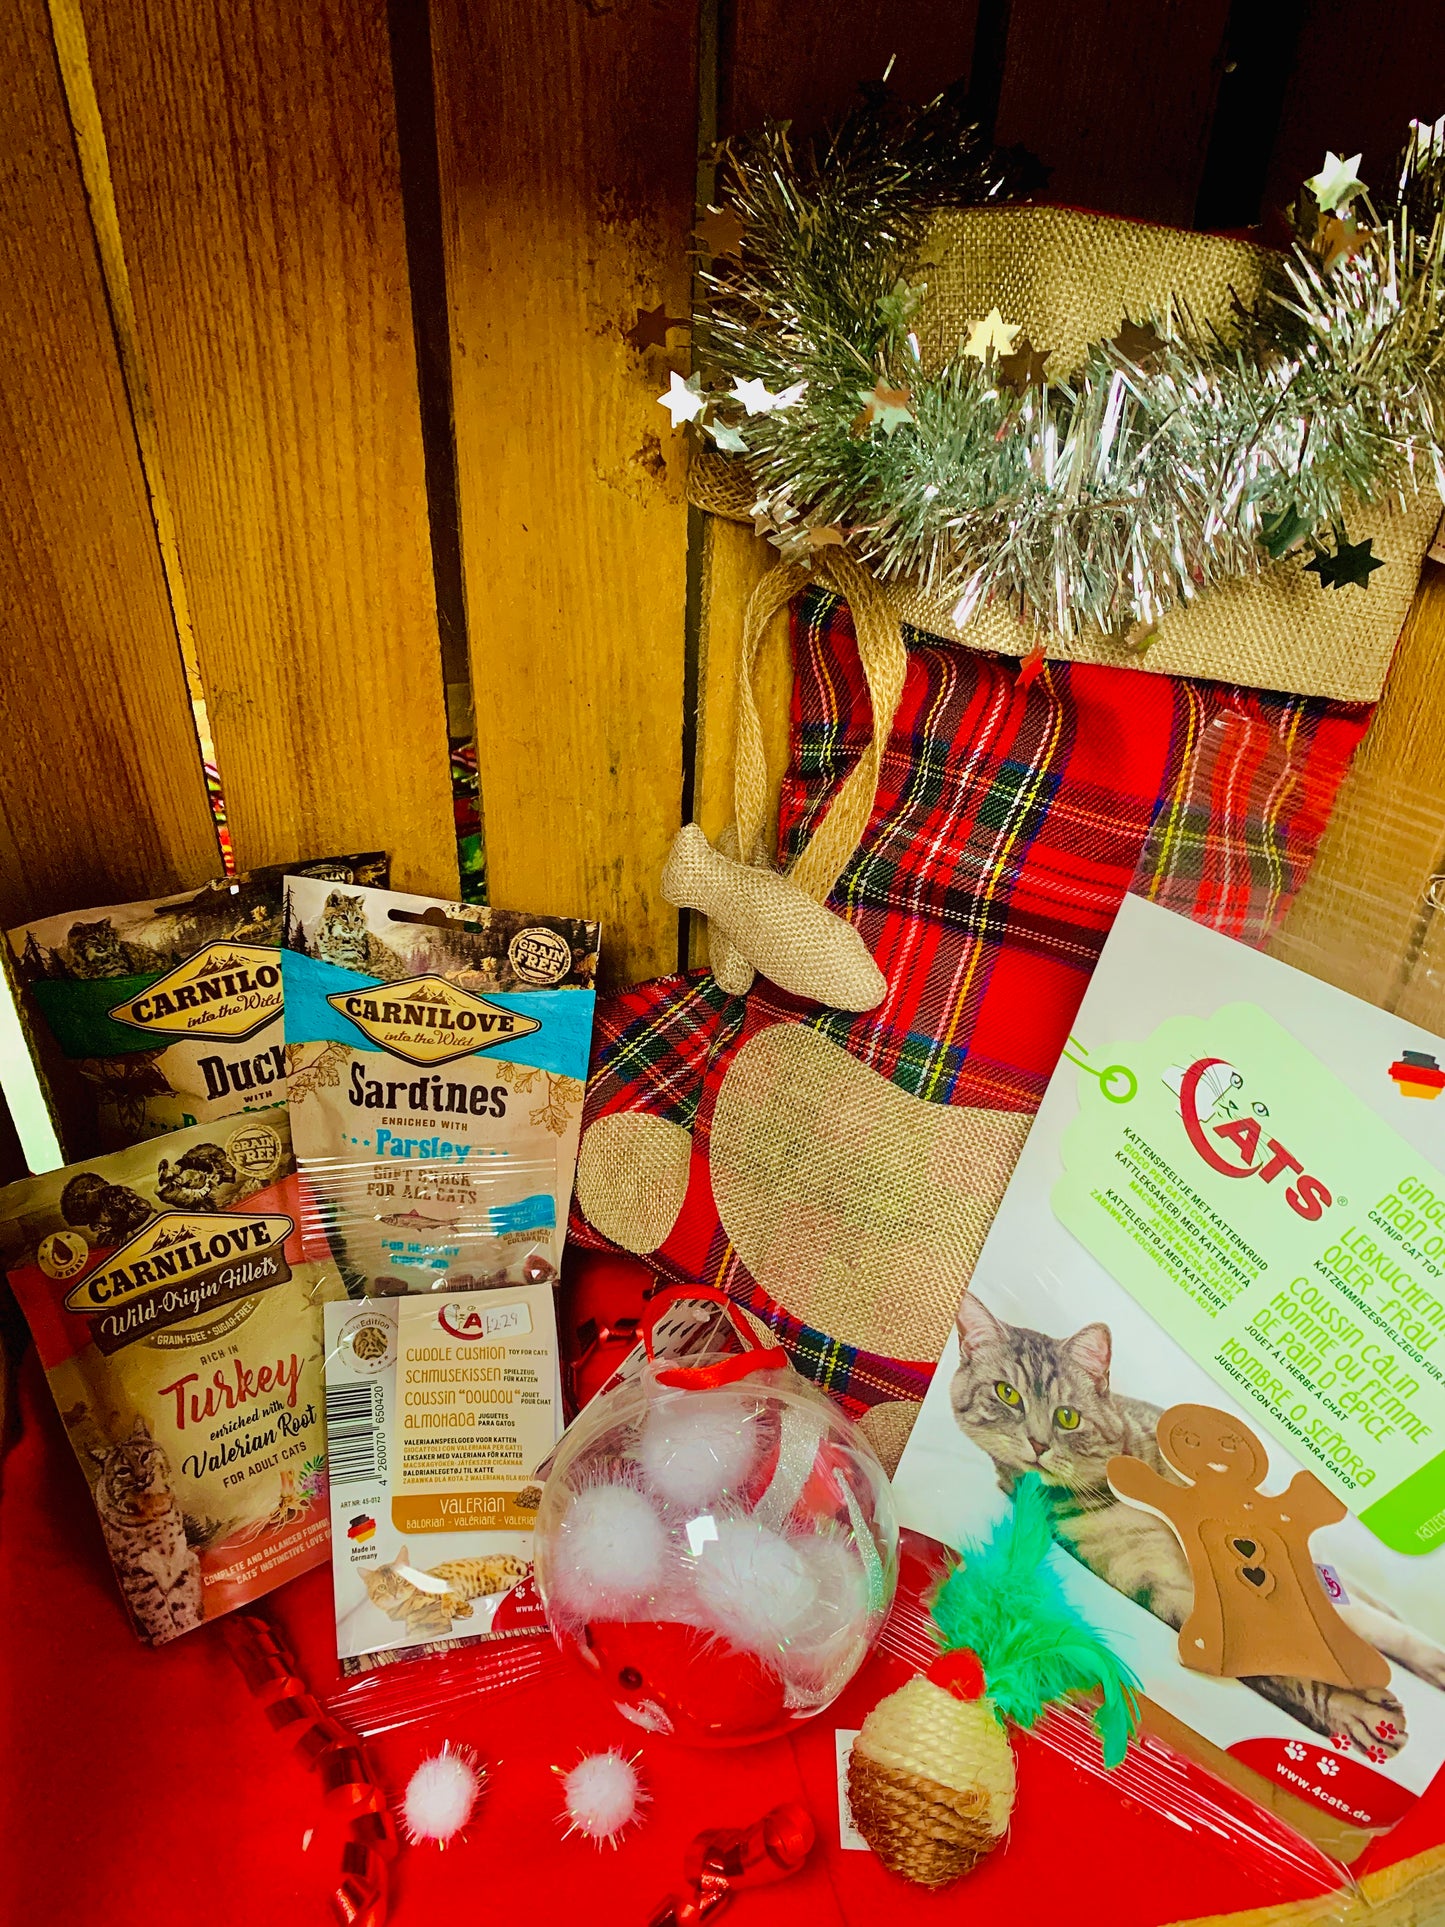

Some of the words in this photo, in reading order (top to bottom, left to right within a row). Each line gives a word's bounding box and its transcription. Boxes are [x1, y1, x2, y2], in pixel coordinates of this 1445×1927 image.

[515, 949, 561, 975] FREE
[519, 939, 564, 963] GRAIN
[131, 962, 282, 1024] CARNILO
[187, 1008, 219, 1028] into
[218, 1003, 242, 1020] the
[236, 991, 283, 1013] Wild
[346, 997, 514, 1033] CARNILOVE
[384, 1031, 417, 1043] into
[415, 1031, 434, 1045] the
[433, 1030, 474, 1048] Wild
[243, 1090, 273, 1103] WITH
[349, 1061, 509, 1118] Sardines
[382, 1116, 437, 1128] ENRICHED
[441, 1120, 469, 1131] WITH
[231, 1136, 275, 1152] GRAIN
[233, 1148, 275, 1164] FREE
[375, 1129, 471, 1165] Parsley
[366, 1183, 395, 1197] FOR
[402, 1185, 431, 1201] ALL
[436, 1188, 478, 1205] CATS
[1123, 1127, 1193, 1197] KATTENSPEELTJE
[1191, 1194, 1211, 1214] MET
[1209, 1212, 1268, 1271] KATTENKRUID
[1123, 1143, 1151, 1171] GIOCO
[1149, 1168, 1167, 1187] PER
[1165, 1185, 1190, 1212] GATTI
[1189, 1209, 1209, 1229] CON
[1207, 1226, 1231, 1252] ERBA
[1229, 1249, 1259, 1280] GATTA
[1114, 1151, 1182, 1220] KATTLEKSAK(ER)
[1180, 1217, 1200, 1237] MED
[1198, 1235, 1251, 1288] KATTMYNTA
[87, 1221, 271, 1304] CARNILOVE
[1089, 1189, 1129, 1228] ZABAWKA
[1179, 1279, 1197, 1298] DLA
[1195, 1295, 1220, 1319] KOTA
[1367, 1210, 1404, 1242] CATNIP
[1401, 1241, 1423, 1261] CAT
[1421, 1258, 1443, 1279] TOY
[100, 1283, 222, 1337] Wild-Origin
[219, 1255, 279, 1294] Fillets
[1163, 1249, 1184, 1269] MED
[1182, 1267, 1228, 1311] KATTEURT
[157, 1330, 207, 1346] GRAIN-FREE
[211, 1300, 254, 1337] SUGAR-FREE
[360, 1318, 390, 1330] Edition
[438, 1302, 484, 1341] CA
[1252, 1308, 1282, 1337] DE
[1313, 1259, 1424, 1364] KATZENMINZESPIELZEUG
[1421, 1361, 1442, 1382] FÜR
[200, 1349, 226, 1366] RICH
[228, 1344, 240, 1356] IN
[1244, 1325, 1274, 1353] JOUET
[1321, 1397, 1349, 1422] CHAT
[158, 1353, 305, 1430] Turkey
[503, 1375, 515, 1383] FÜR
[210, 1409, 260, 1442] enriched
[261, 1399, 285, 1419] with
[374, 1386, 385, 1424] 650420
[1214, 1354, 1252, 1391] JUGUETE
[1250, 1389, 1271, 1409] CON
[1269, 1407, 1303, 1437] CATNIP
[1300, 1436, 1325, 1462] PARA
[1325, 1460, 1357, 1490] GATOS
[1289, 1405, 1308, 1422] O
[182, 1429, 278, 1479] Valerian
[276, 1403, 317, 1438] Root
[377, 1432, 388, 1471] 260070
[404, 1437, 474, 1446] VALERIAANSPEELGOED
[223, 1472, 246, 1489] FOR
[248, 1453, 280, 1477] ADULT
[282, 1441, 307, 1461] CATS
[378, 1479, 388, 1487] 4
[203, 1561, 246, 1586] COMPLETE
[247, 1552, 263, 1567] AND
[263, 1533, 302, 1558] BALANCED
[260, 1543, 305, 1572] INSTINCTIVE
[306, 1532, 324, 1549] LOVE
[350, 1552, 378, 1563] Germany
[351, 1546, 368, 1555] Made
[1276, 1763, 1371, 1822] www.4cats.de
